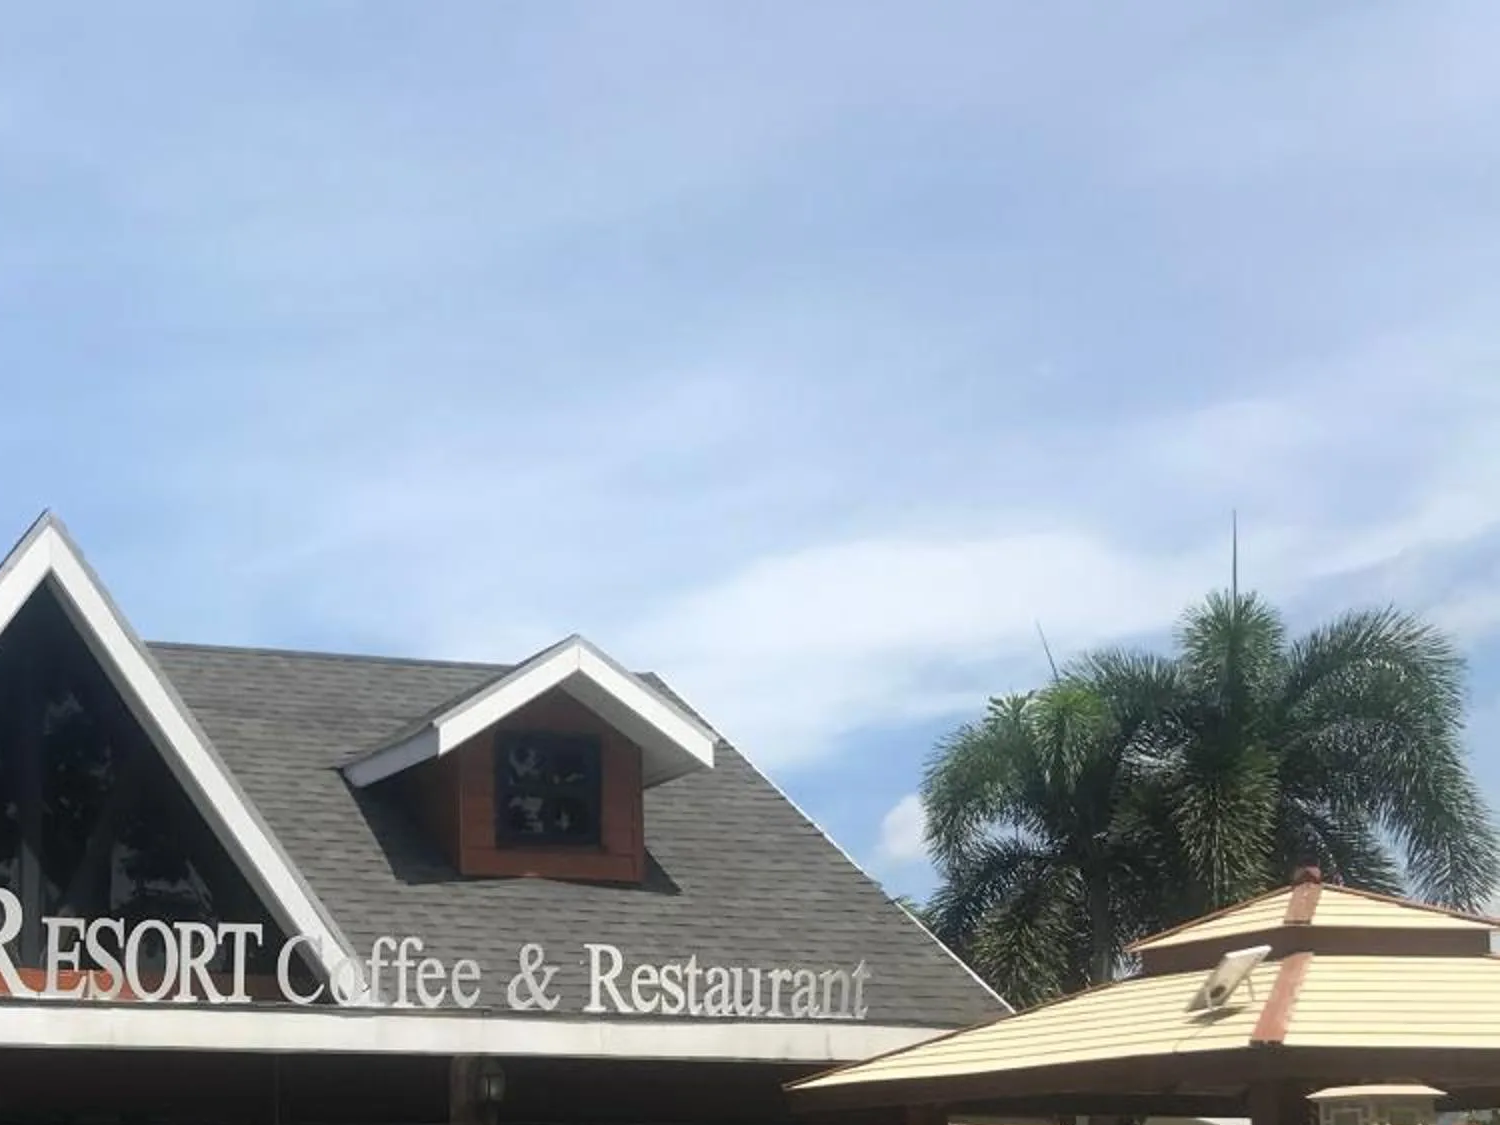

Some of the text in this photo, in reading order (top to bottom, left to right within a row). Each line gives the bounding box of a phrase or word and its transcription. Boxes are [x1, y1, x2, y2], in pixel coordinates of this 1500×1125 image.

[277, 935, 481, 1008] Coffee
[507, 943, 560, 1011] &
[583, 943, 871, 1020] Restaurant
